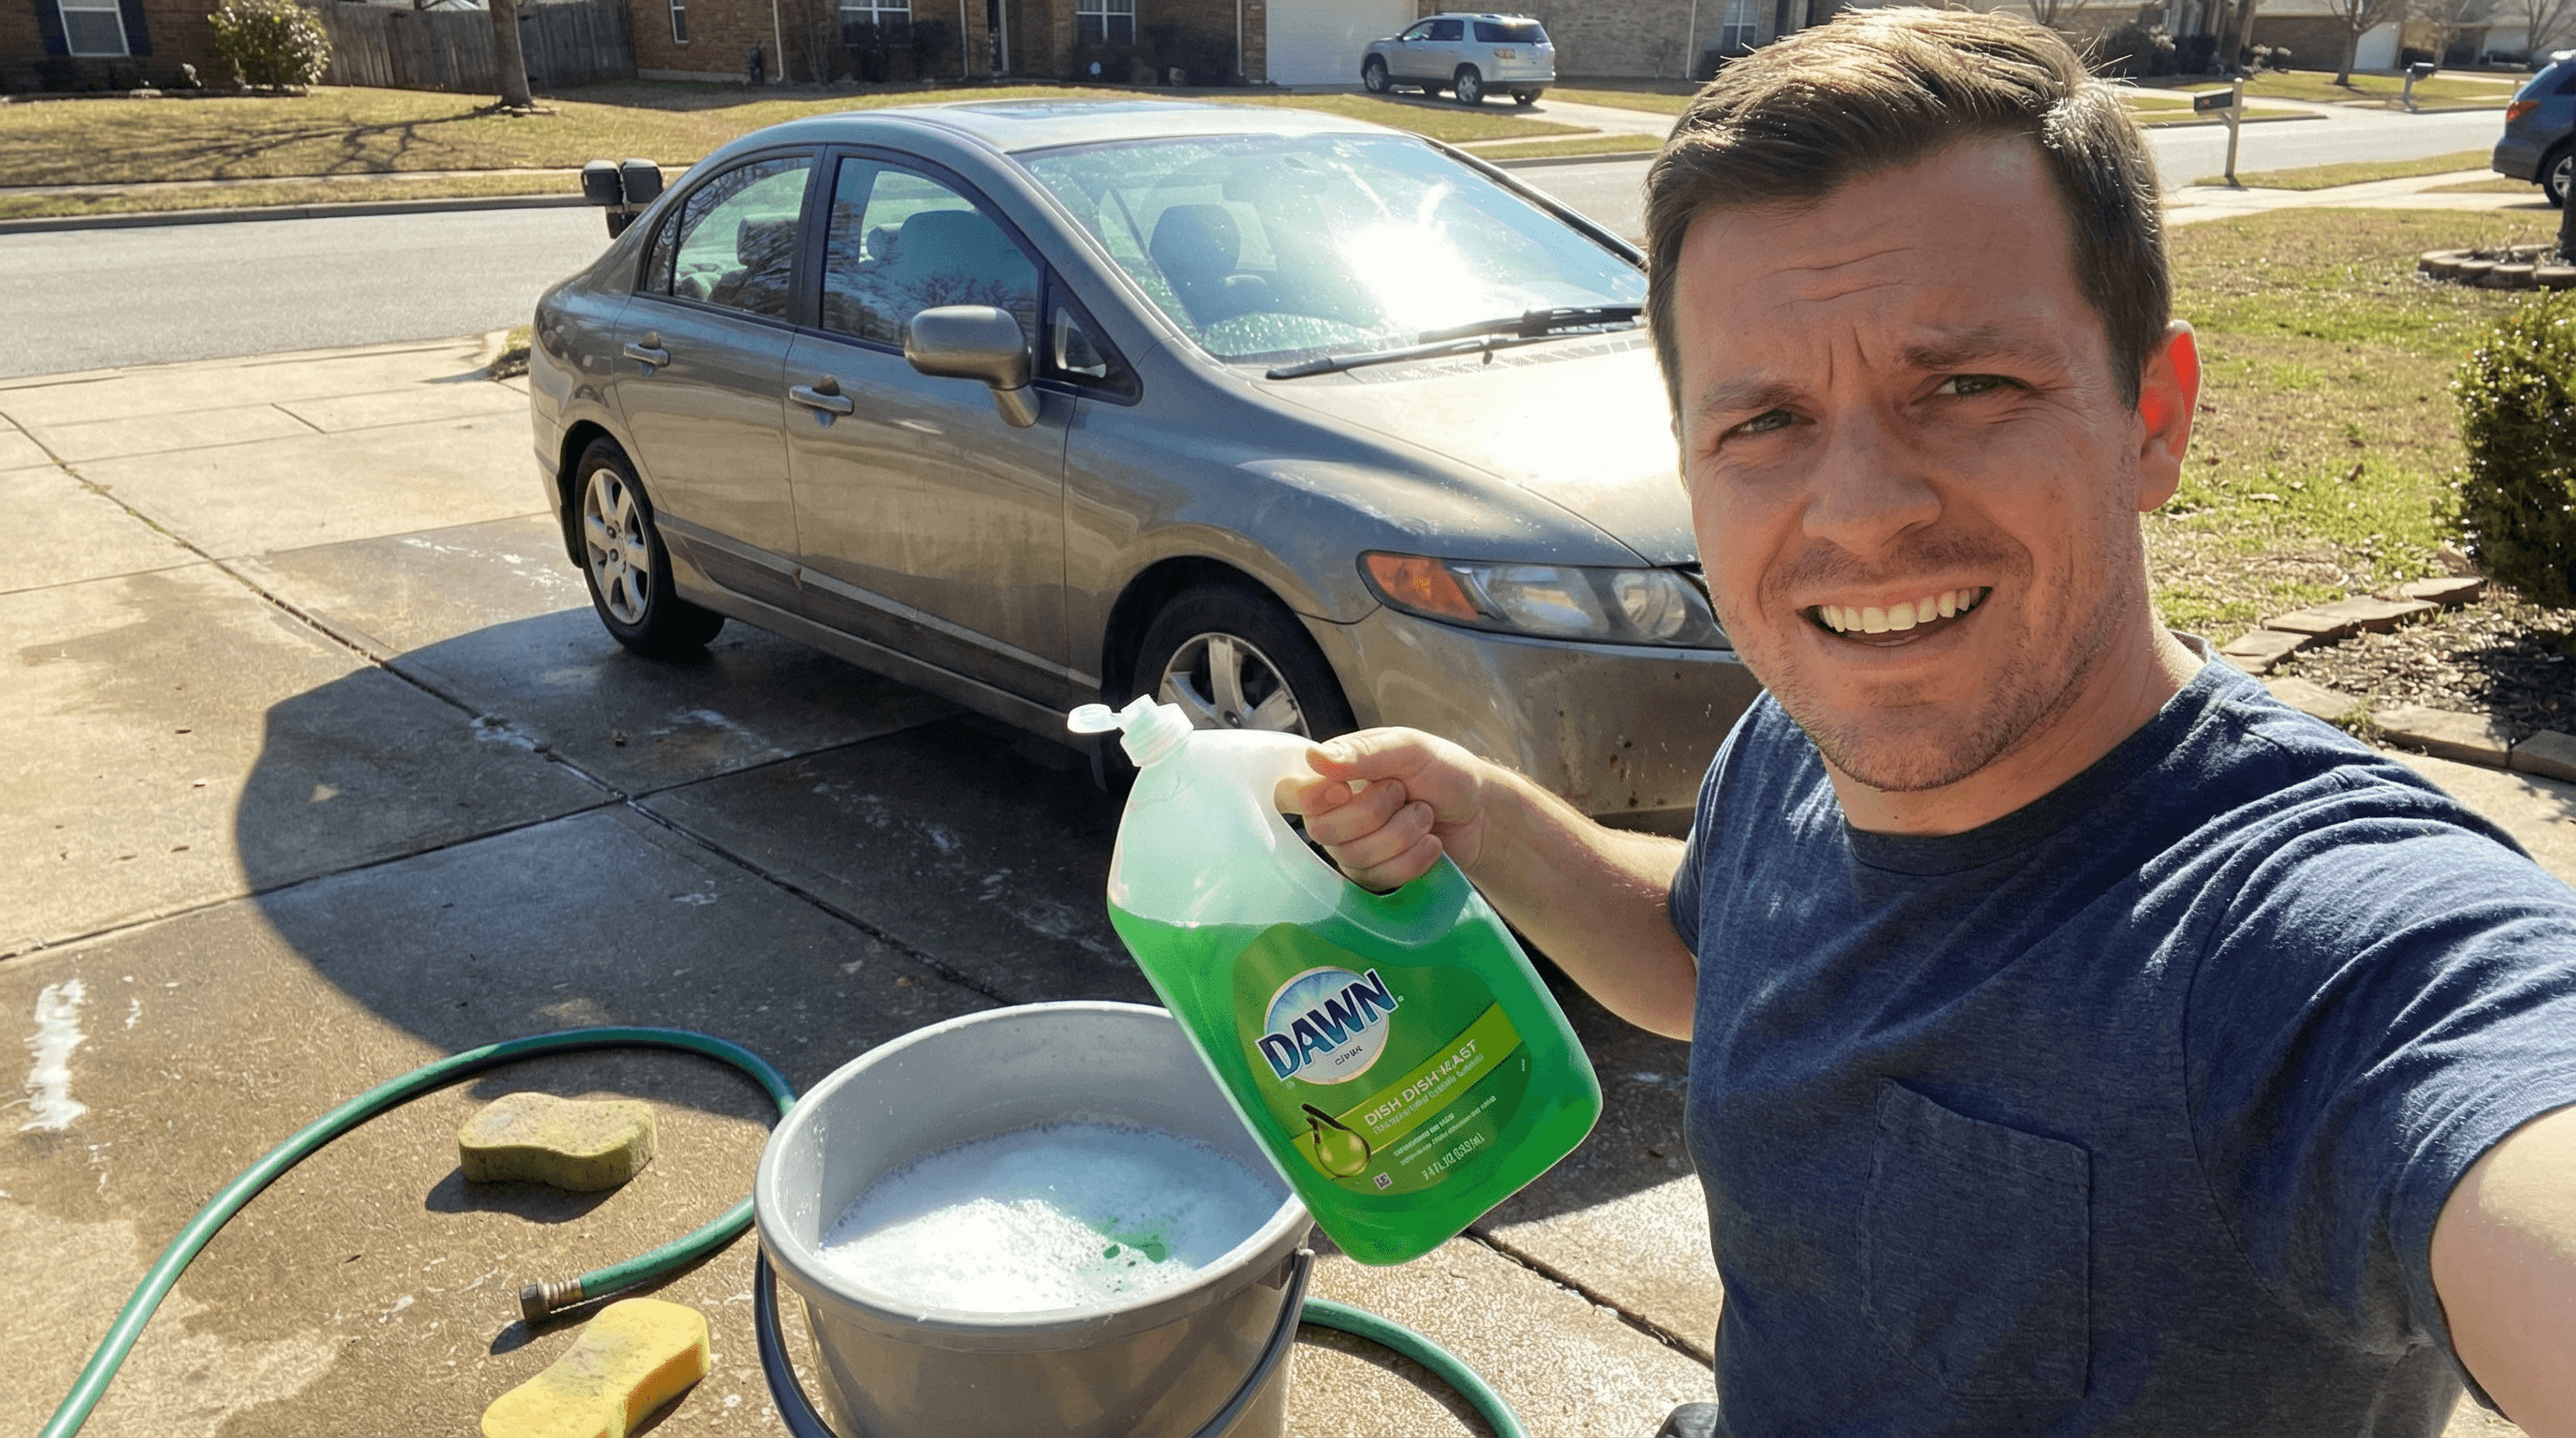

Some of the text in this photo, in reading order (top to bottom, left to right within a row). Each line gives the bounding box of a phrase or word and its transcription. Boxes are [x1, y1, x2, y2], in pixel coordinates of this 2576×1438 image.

[1255, 968, 1398, 1080] DAWN
[1364, 1097, 1402, 1126] DISH
[1402, 1071, 1440, 1103] DISH
